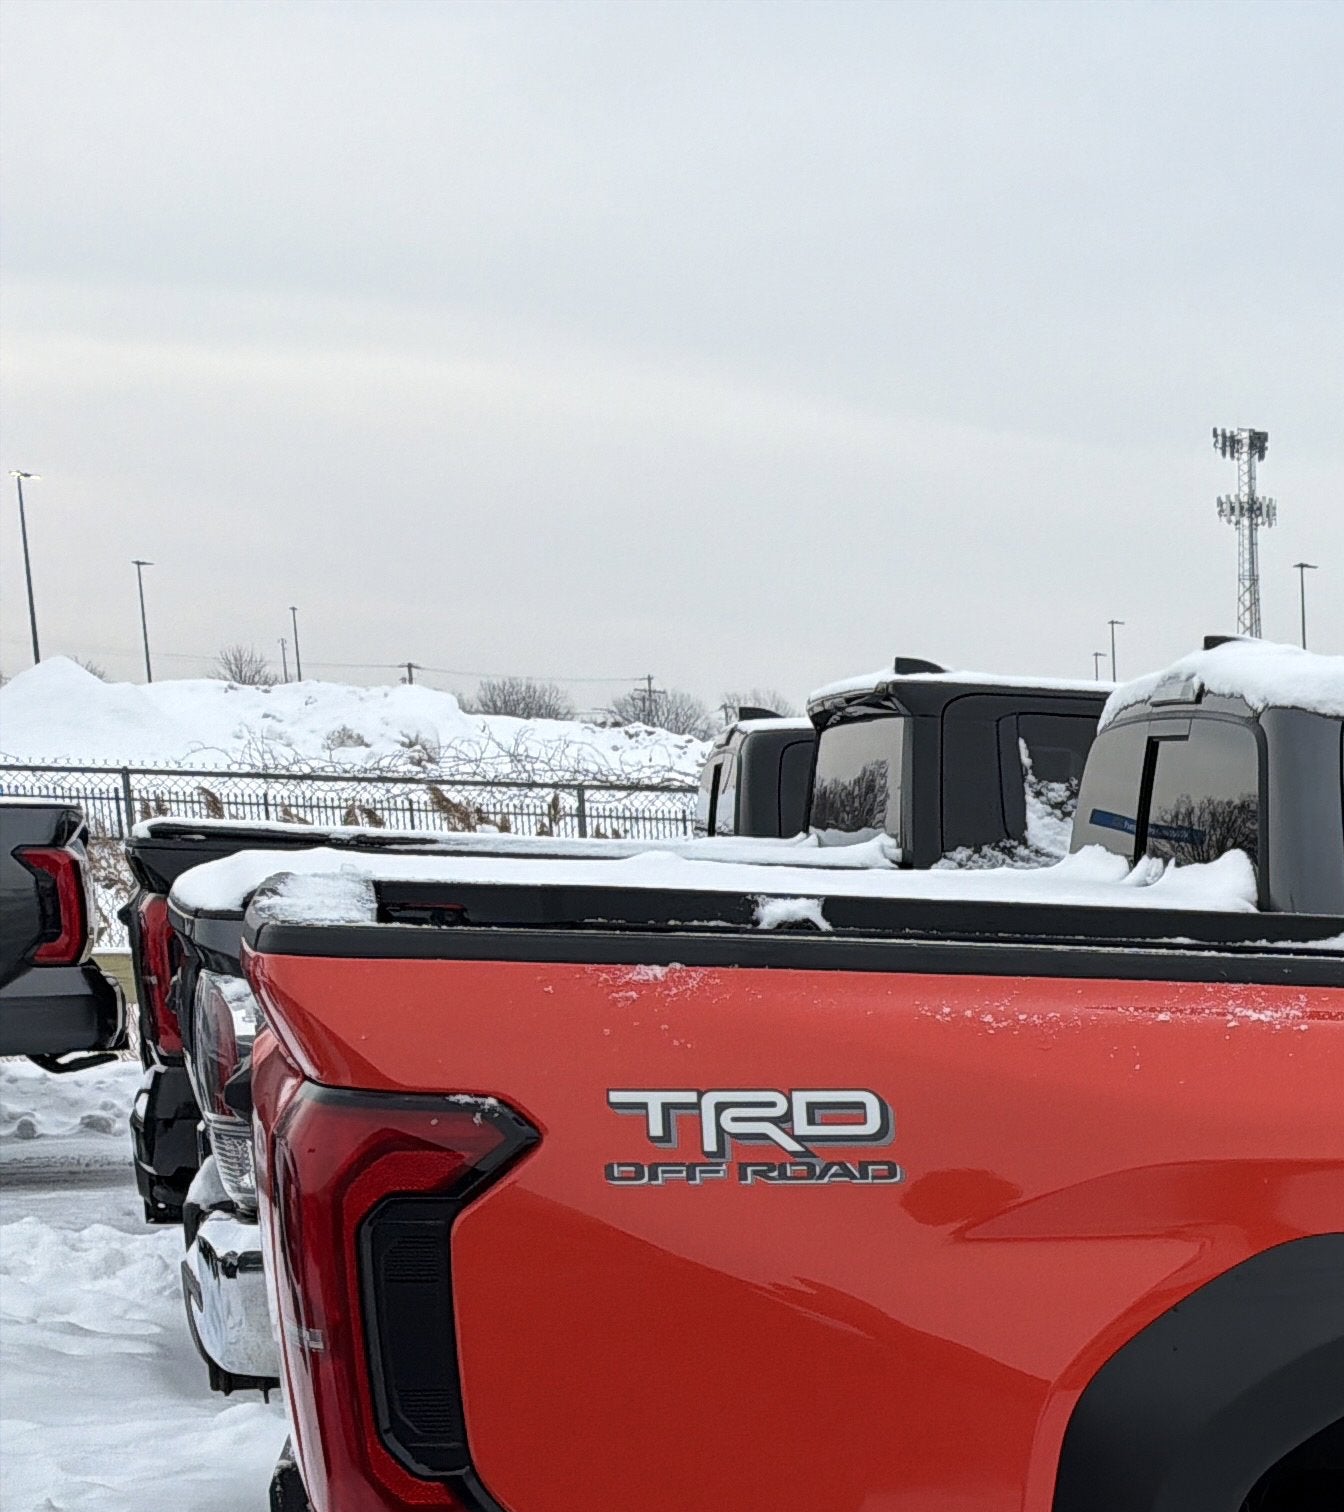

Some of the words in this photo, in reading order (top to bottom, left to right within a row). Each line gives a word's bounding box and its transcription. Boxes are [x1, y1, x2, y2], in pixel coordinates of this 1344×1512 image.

[607, 1088, 895, 1162] TRD
[605, 1161, 726, 1185] OFF
[738, 1160, 906, 1185] ROAD
